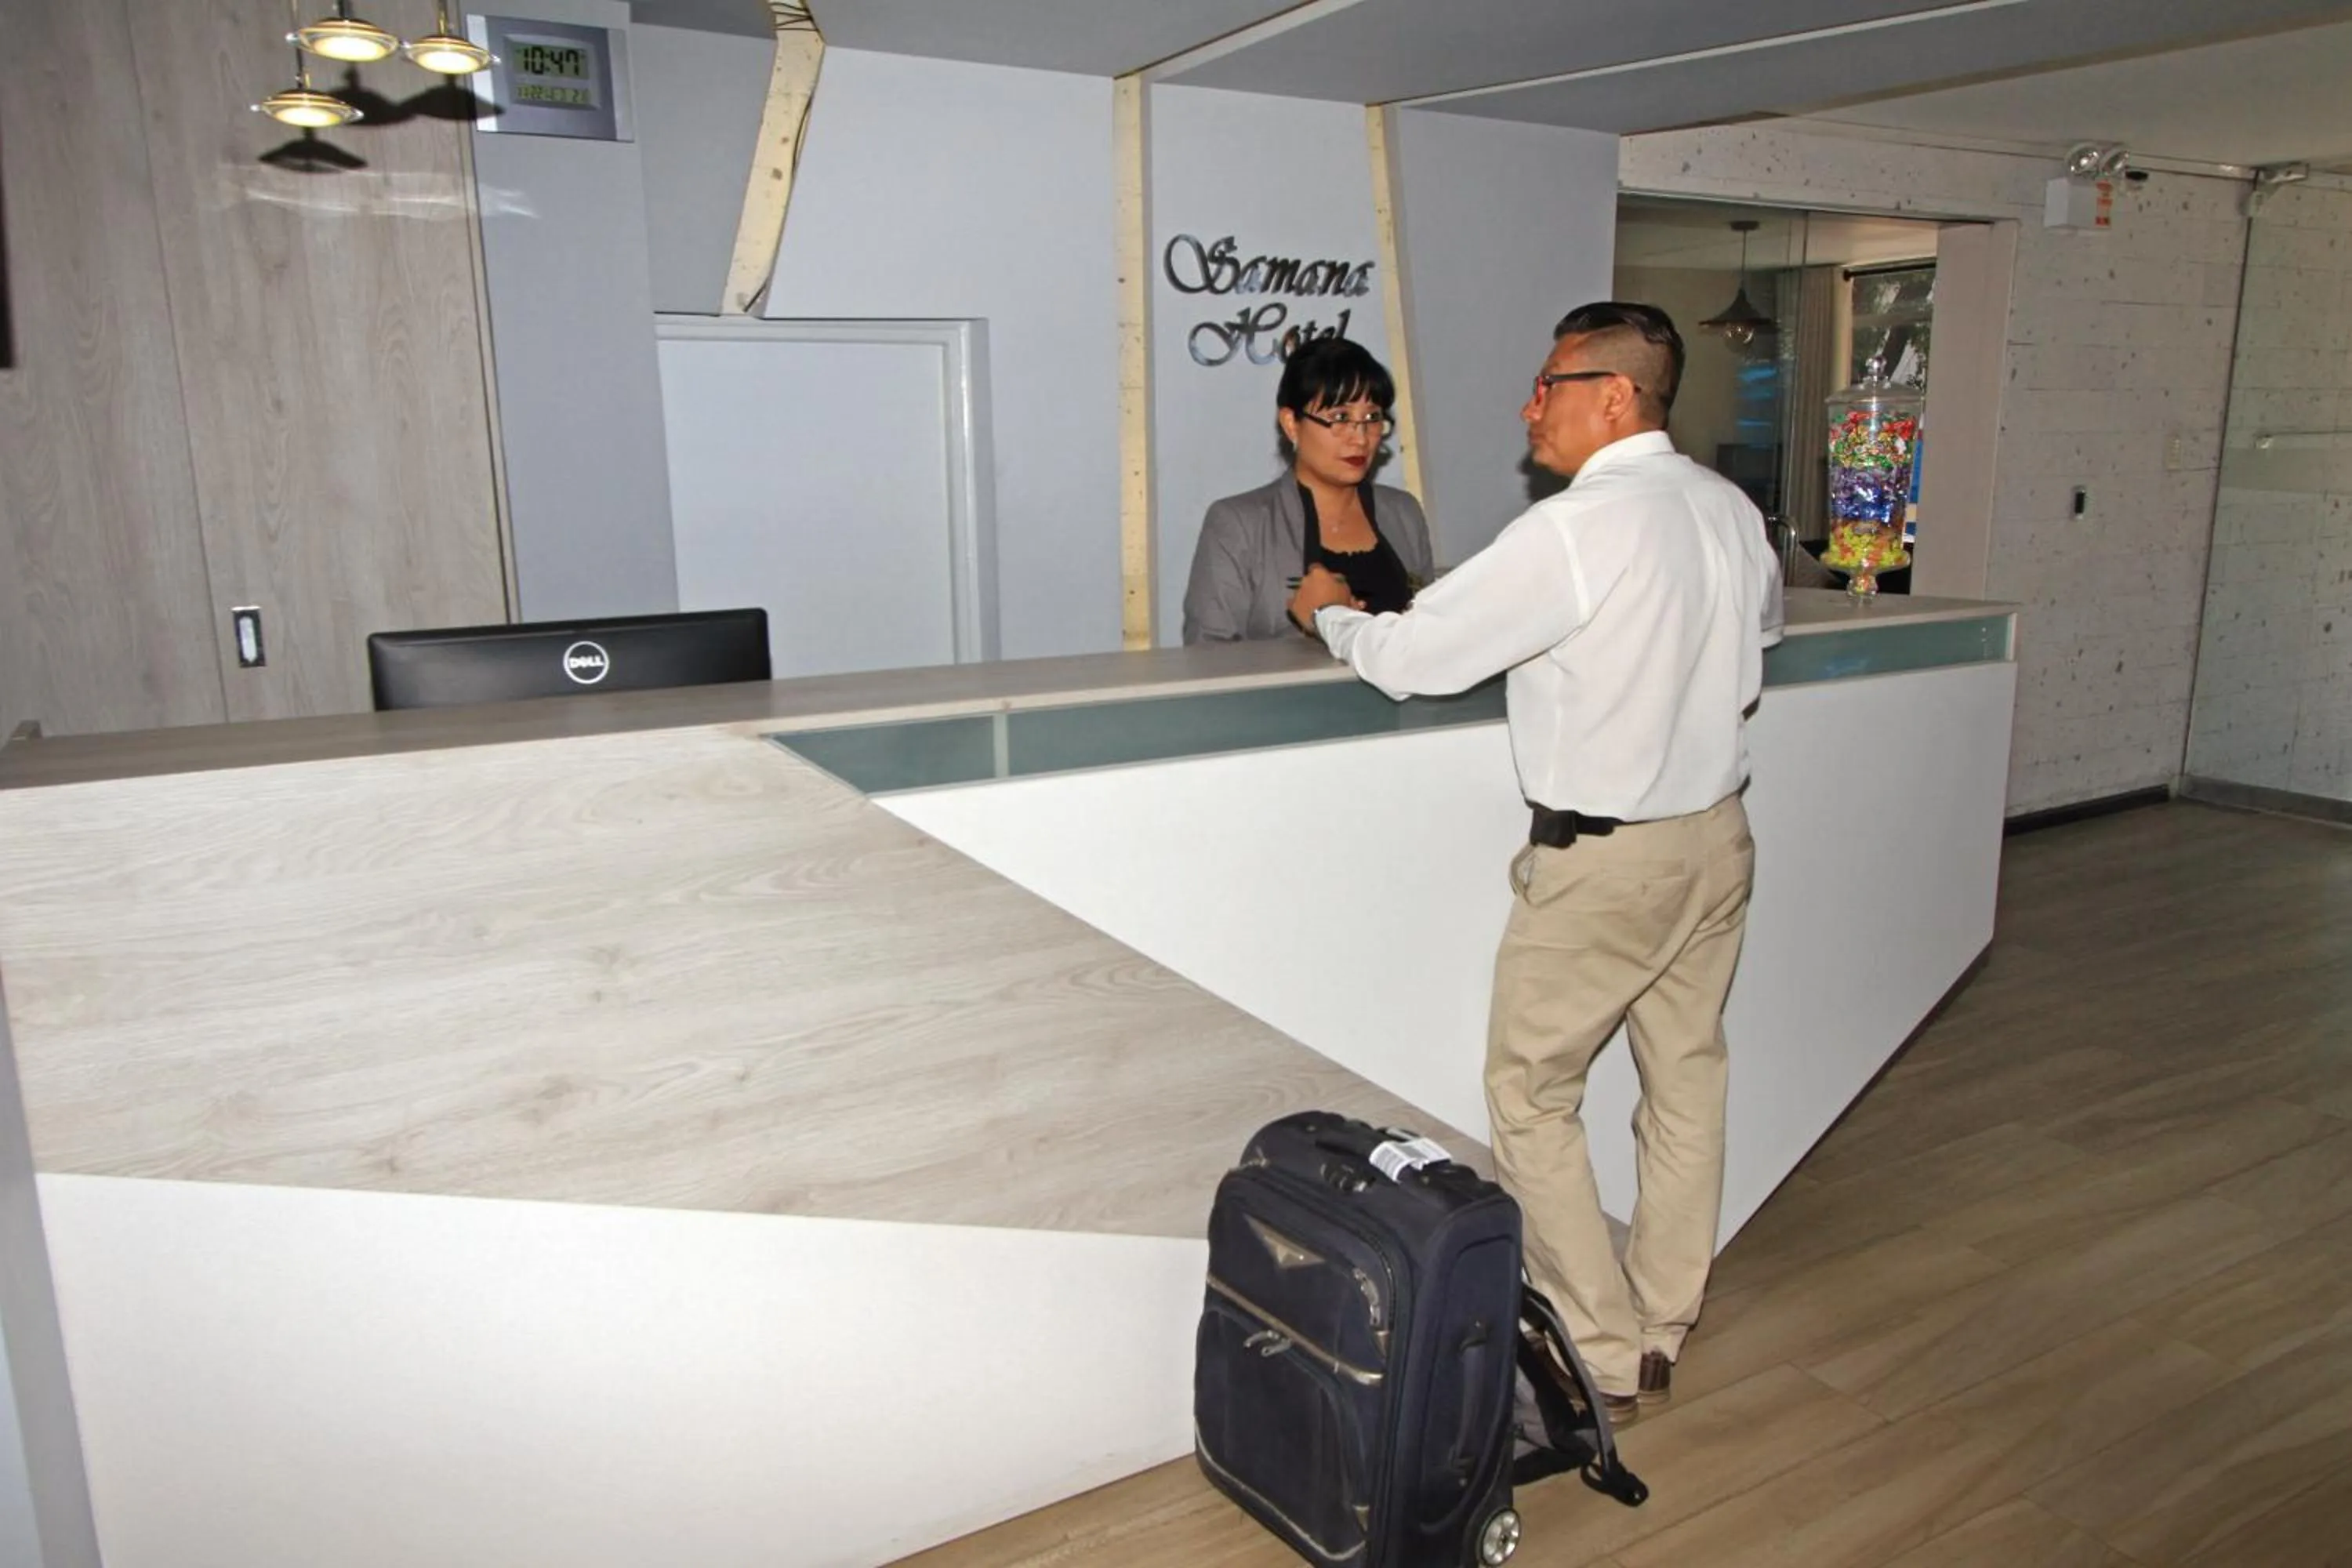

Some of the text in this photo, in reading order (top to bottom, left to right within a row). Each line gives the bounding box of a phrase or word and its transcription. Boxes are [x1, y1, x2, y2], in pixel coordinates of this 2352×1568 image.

[523, 45, 579, 76] 10:47
[1163, 234, 1375, 296] Samana
[569, 655, 604, 669] DELL
